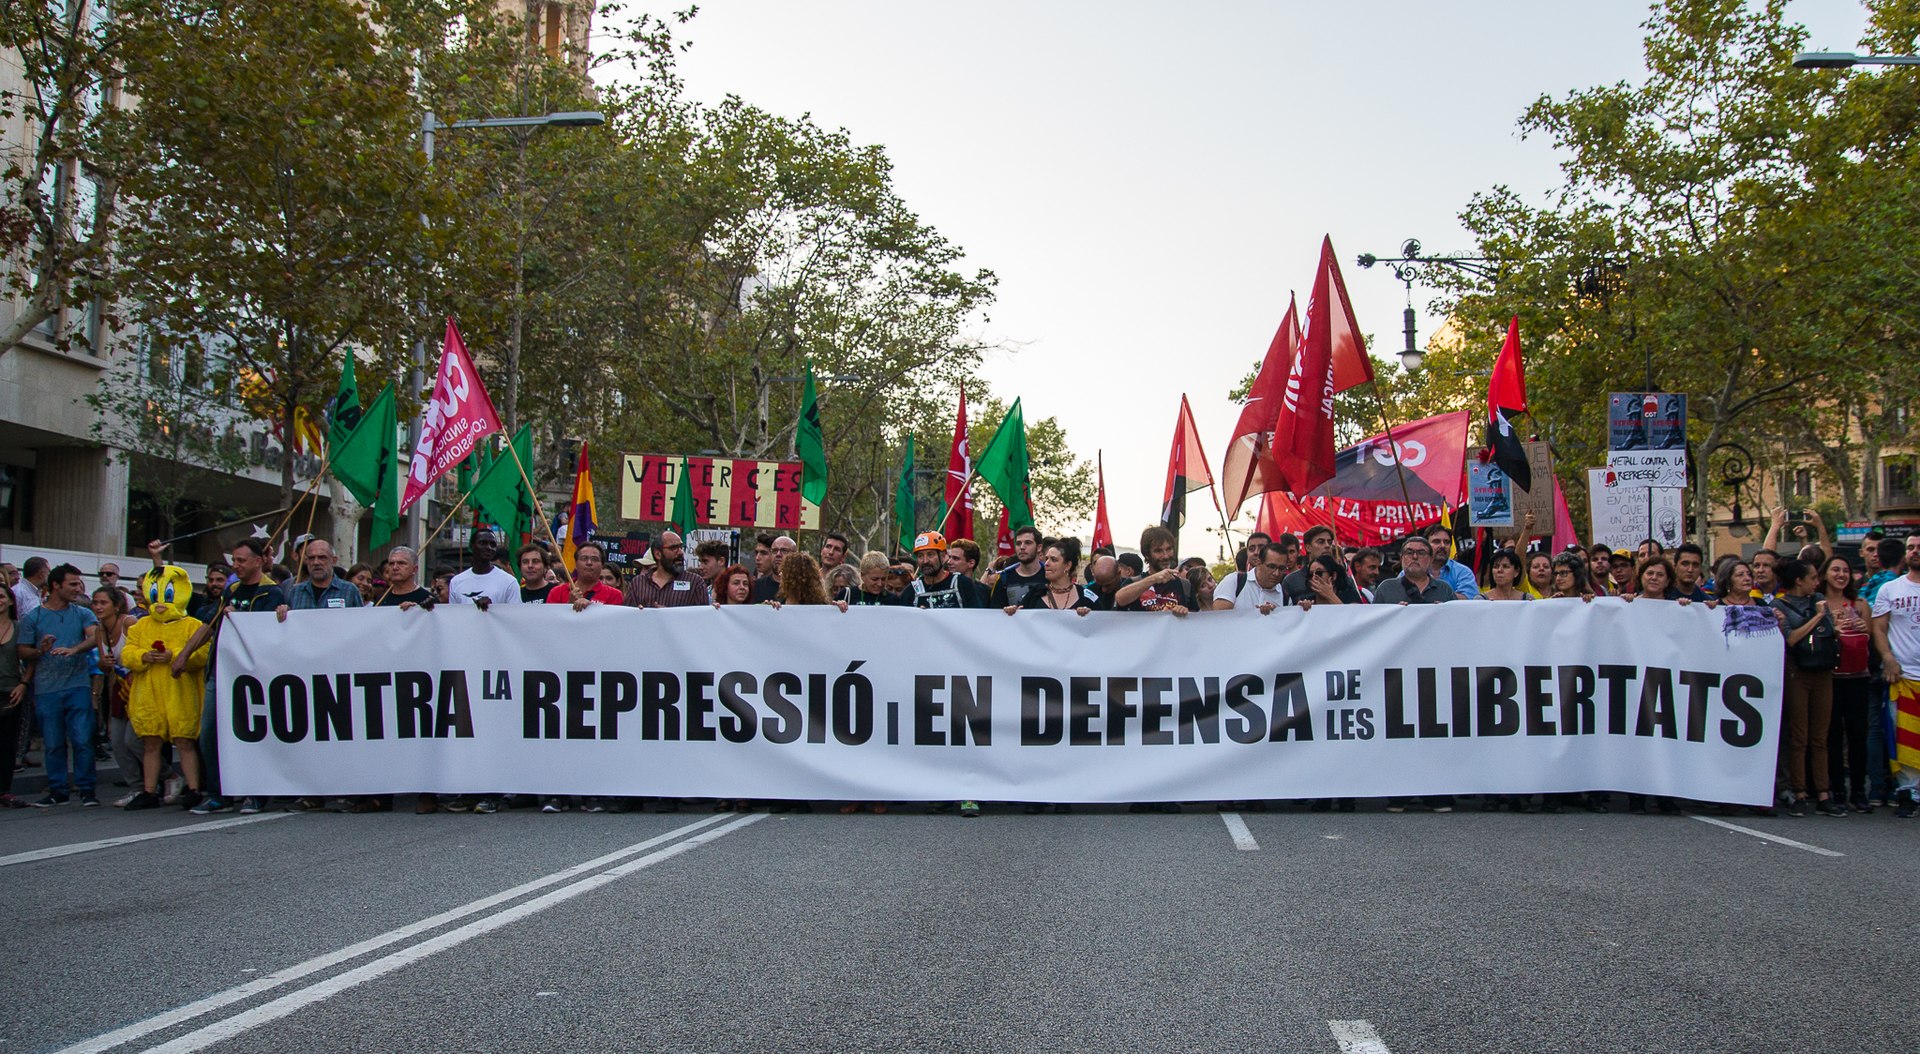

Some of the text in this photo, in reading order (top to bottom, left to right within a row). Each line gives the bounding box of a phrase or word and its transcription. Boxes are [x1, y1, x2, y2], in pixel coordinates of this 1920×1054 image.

[1640, 456, 1669, 467] CONTRA
[1674, 456, 1684, 466] LA
[1617, 467, 1661, 482] REPRESSIÓ
[1337, 499, 1361, 522] LA
[1374, 502, 1451, 524] PRIVATI
[1620, 505, 1643, 515] QUE
[1621, 524, 1645, 533] COMO
[1895, 595, 1920, 610] SANT
[232, 670, 474, 743] CONTRA
[483, 670, 512, 700] LA
[523, 661, 873, 746] REPRESSIÓ
[915, 674, 992, 747] EN
[1021, 671, 1313, 747] DEFENSA
[1325, 669, 1361, 701] DE
[1384, 665, 1764, 748] LLIBERTATS
[1326, 707, 1375, 741] LES
